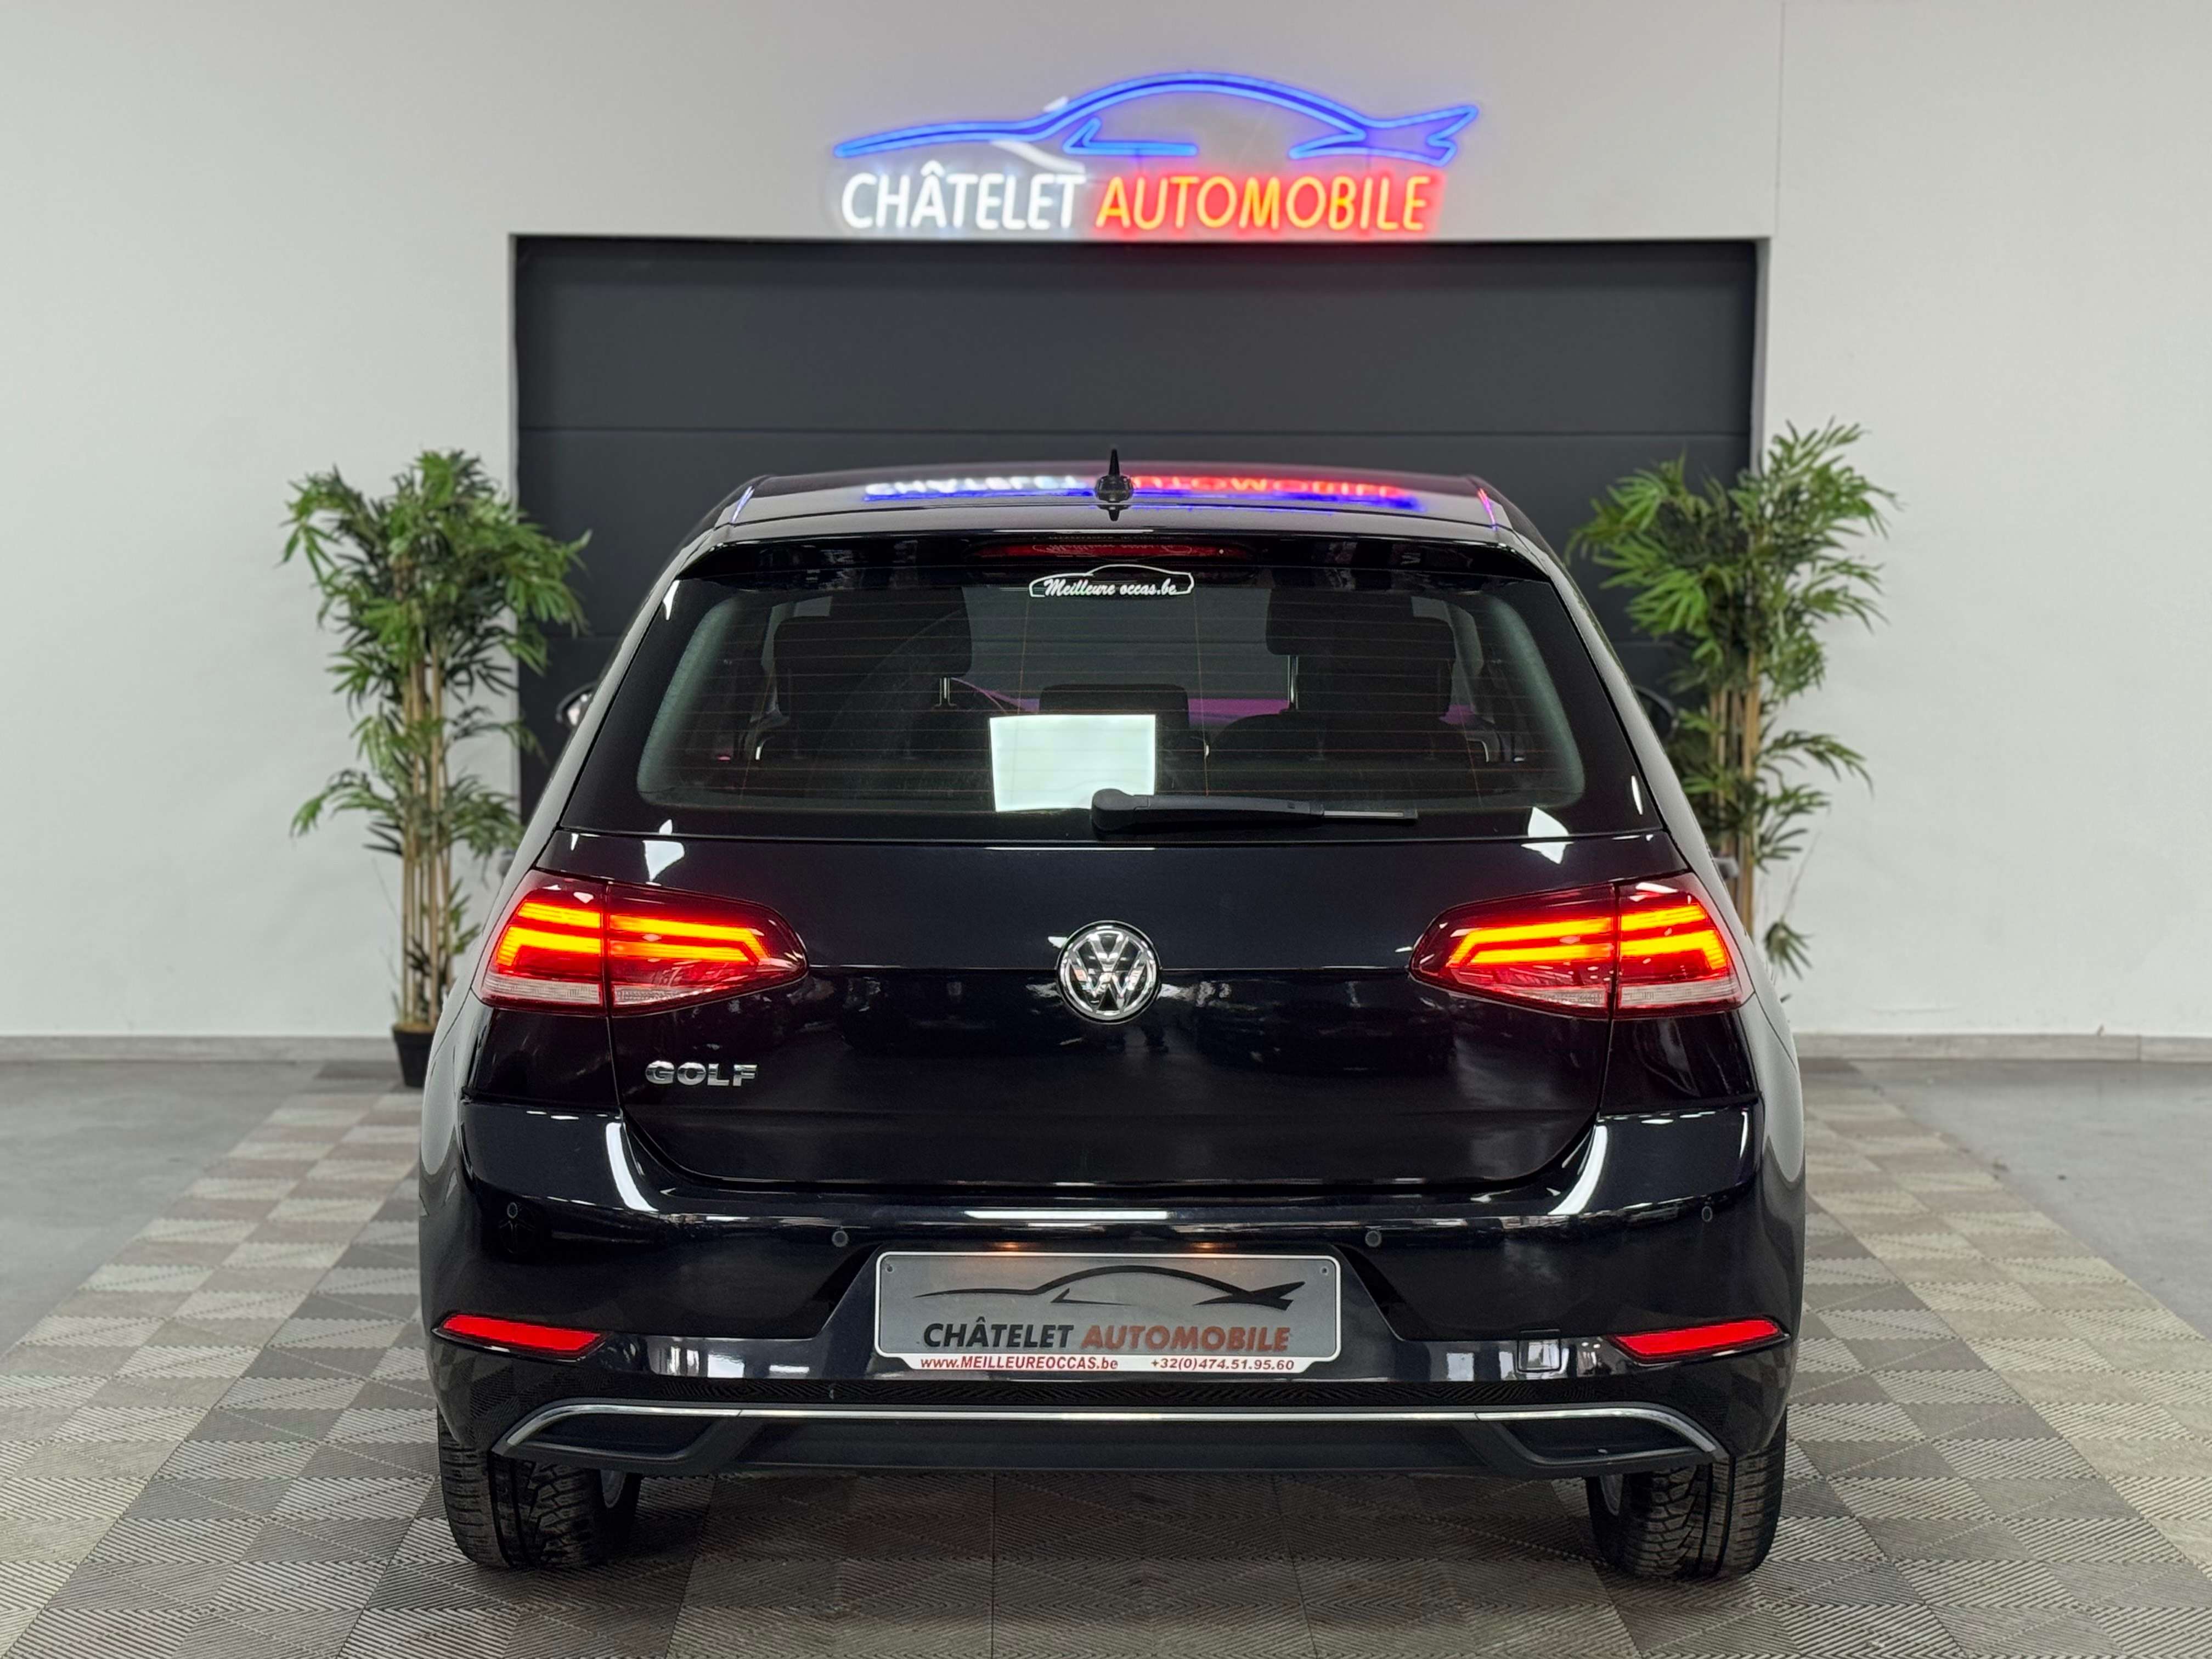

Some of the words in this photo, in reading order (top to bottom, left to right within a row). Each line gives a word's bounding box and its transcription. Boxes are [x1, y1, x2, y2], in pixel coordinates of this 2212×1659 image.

[841, 160, 1087, 230] CHÂTELET
[1095, 176, 1430, 230] AUTOMOBILE
[1043, 578, 1116, 596] Meilleure
[1120, 578, 1177, 596] occas.be
[645, 1060, 757, 1087] GOLF
[923, 1316, 1074, 1348] CHÂTELET
[1080, 1325, 1291, 1352] AUTOMOBILE
[921, 1356, 1118, 1369] www.MEILLEUREOCCAS.be
[1151, 1358, 1295, 1370] +32(0)474.51.95.60
